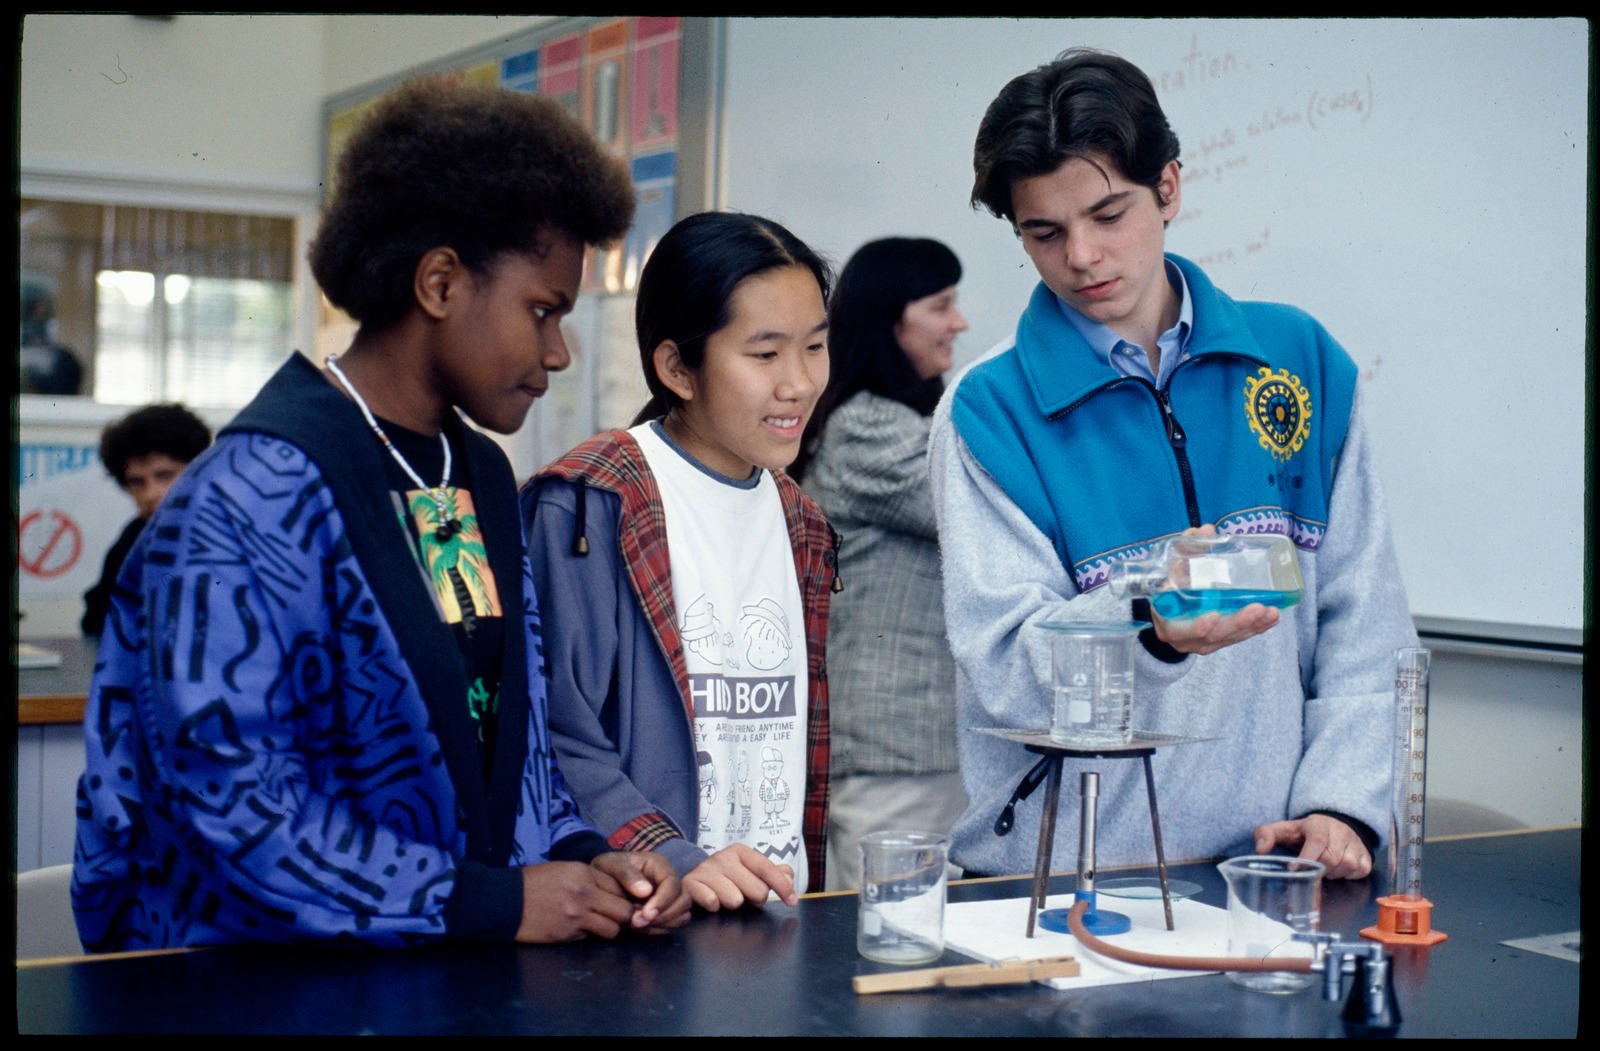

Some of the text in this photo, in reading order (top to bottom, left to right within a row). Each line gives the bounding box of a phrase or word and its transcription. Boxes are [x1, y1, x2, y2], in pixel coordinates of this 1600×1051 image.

[735, 681, 790, 714] BOY
[735, 724, 755, 733] FRIEND
[758, 721, 794, 731] ANYTIME
[750, 733, 766, 742] EASY
[773, 731, 791, 741] LIFE
[1413, 728, 1425, 737] 90
[1412, 750, 1424, 759] 80
[1411, 772, 1423, 781] 70
[1411, 793, 1423, 803] 60
[1410, 815, 1422, 824] 50
[1409, 836, 1421, 846] 40
[1409, 858, 1420, 867] 30
[1408, 879, 1420, 889] 20
